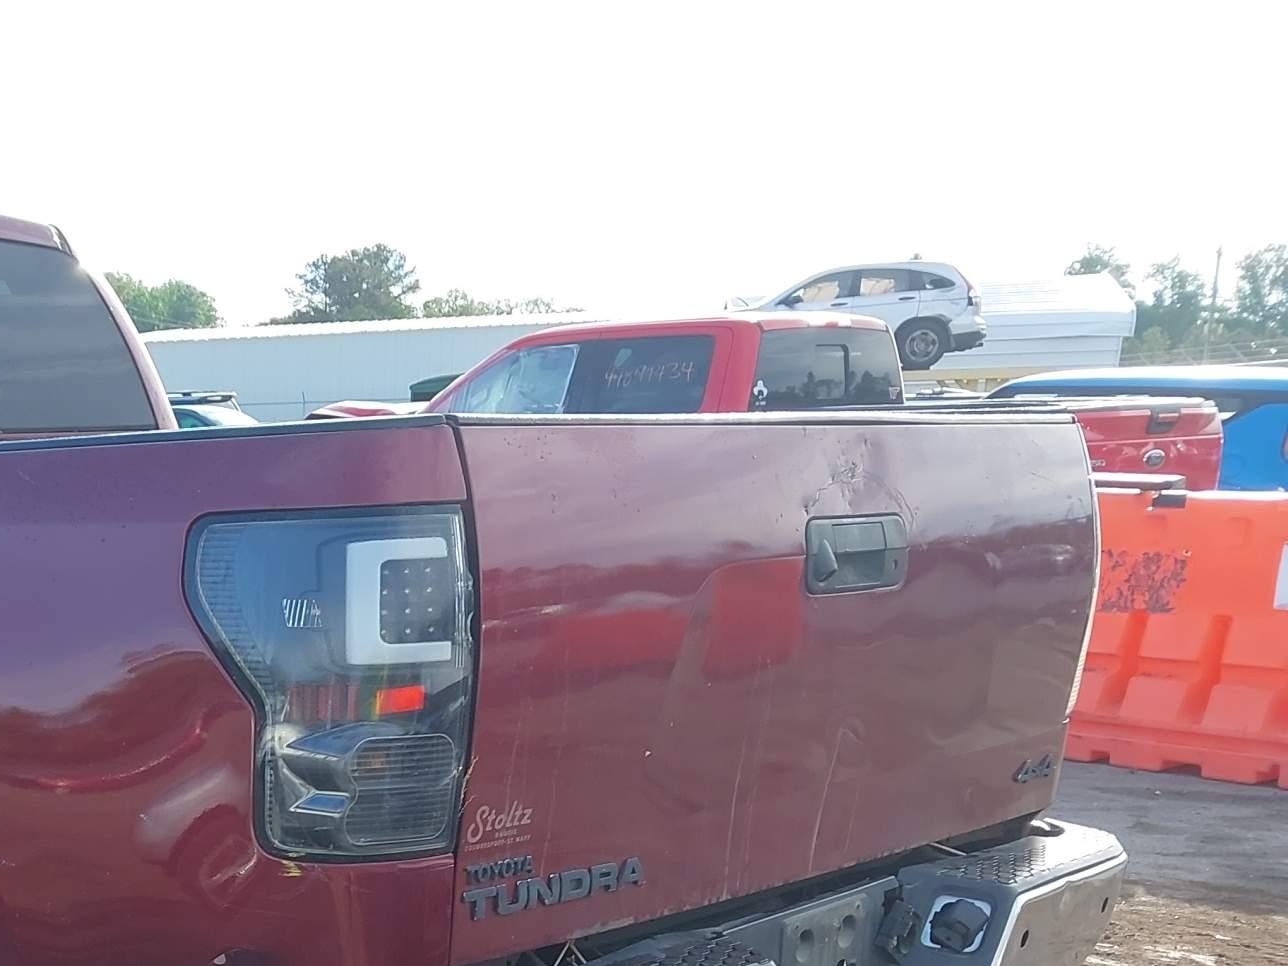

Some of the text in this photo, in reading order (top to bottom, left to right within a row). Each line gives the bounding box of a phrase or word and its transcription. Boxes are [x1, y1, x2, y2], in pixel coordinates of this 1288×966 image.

[466, 800, 533, 844] Stoltz
[462, 857, 647, 921] TUNDRA
[465, 855, 533, 884] TOYOTA
